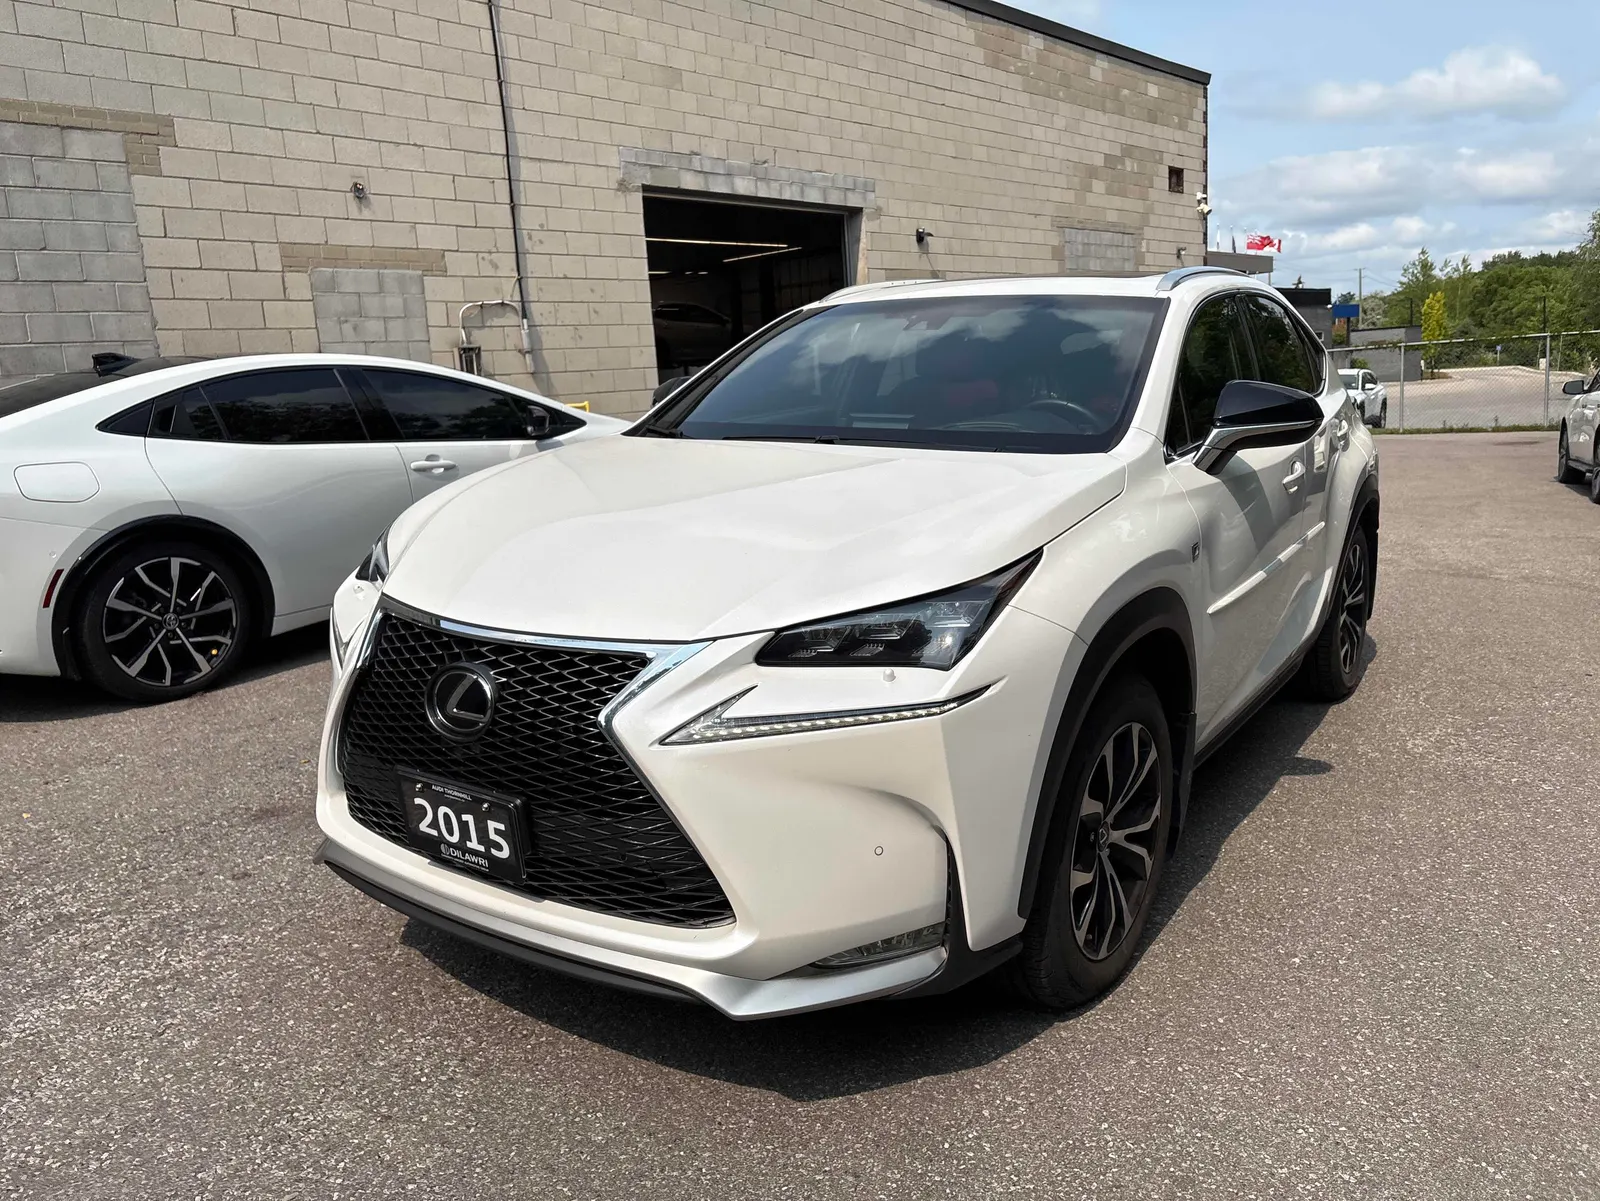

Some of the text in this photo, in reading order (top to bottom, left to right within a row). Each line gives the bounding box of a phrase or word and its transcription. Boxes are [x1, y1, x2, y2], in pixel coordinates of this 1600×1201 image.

[431, 784, 444, 793] AUDI
[413, 797, 510, 859] 2015
[449, 847, 489, 868] DILAWRI
